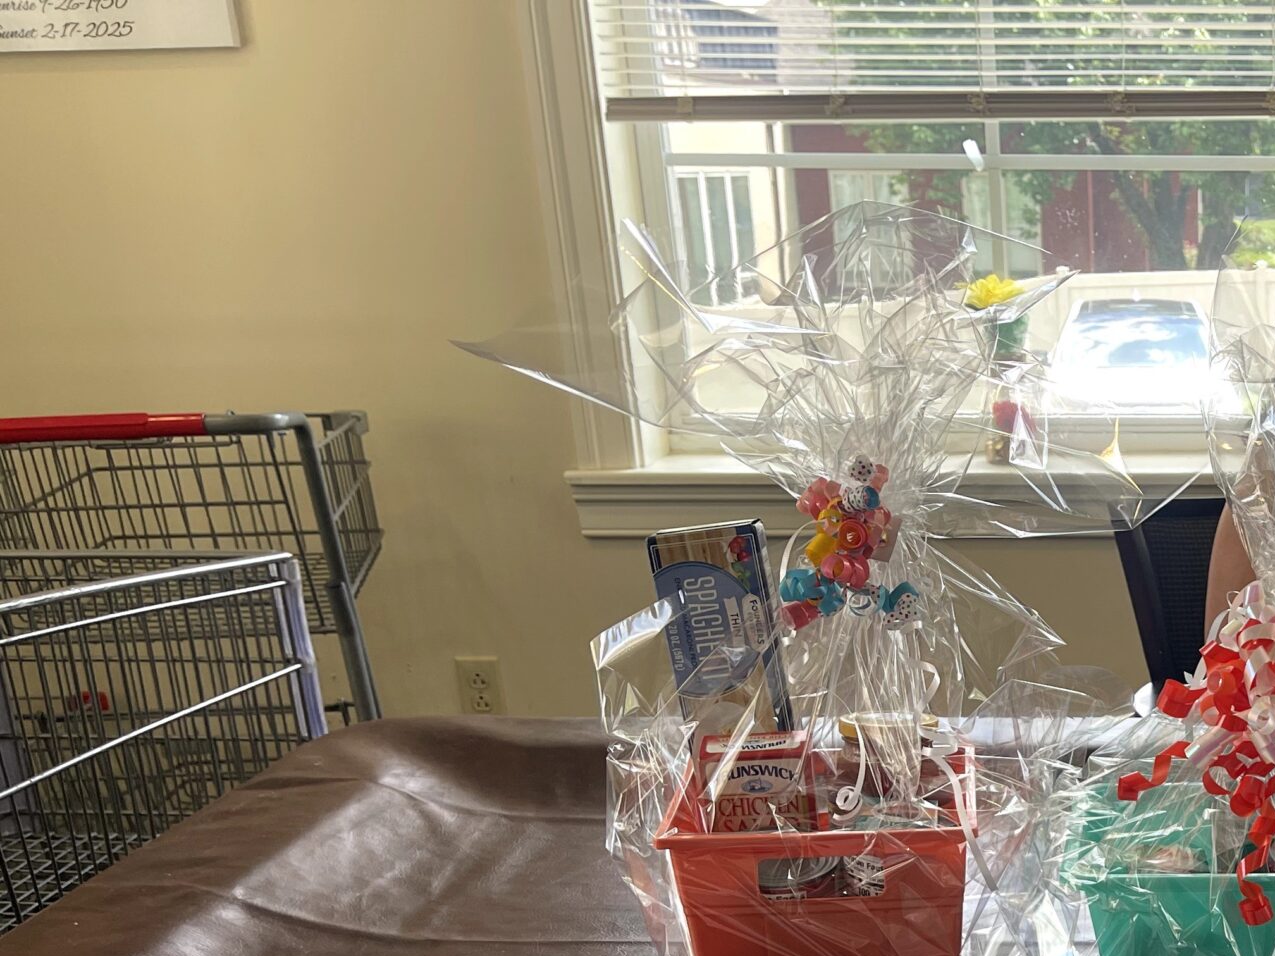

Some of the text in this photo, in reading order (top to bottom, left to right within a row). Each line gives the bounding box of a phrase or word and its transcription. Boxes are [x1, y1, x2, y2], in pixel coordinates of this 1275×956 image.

[41, 21, 135, 38] 2-17-2025
[683, 575, 731, 680] SPAGHETTI
[729, 613, 743, 638] THIN
